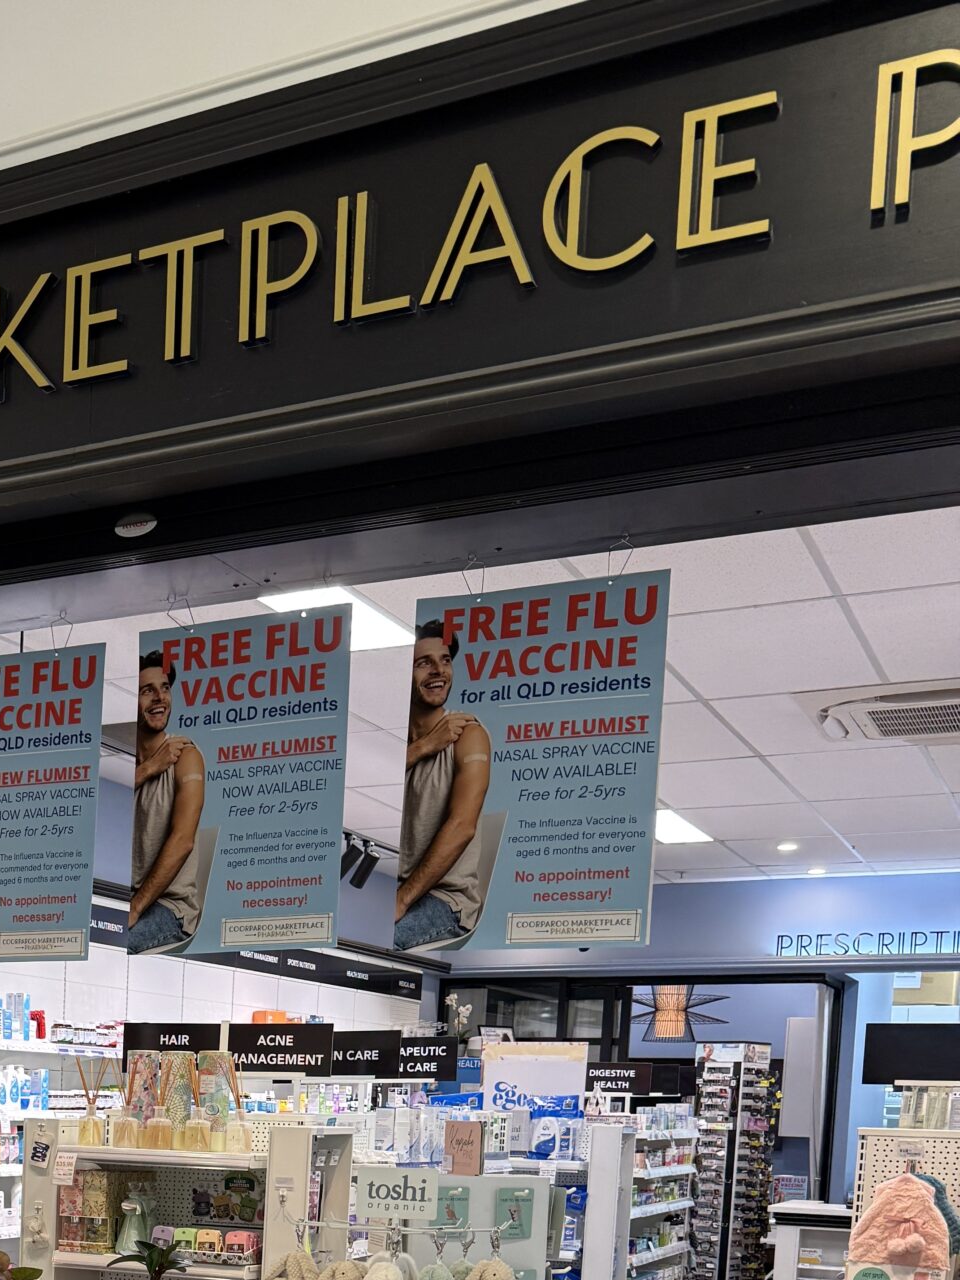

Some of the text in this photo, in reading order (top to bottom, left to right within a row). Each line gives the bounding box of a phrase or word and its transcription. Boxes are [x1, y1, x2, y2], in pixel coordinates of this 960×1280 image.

[442, 584, 659, 646] FREE FLU
[162, 615, 343, 675] FREE FLU
[464, 635, 638, 682] VACCINE
[31, 655, 97, 694] FLU
[181, 662, 326, 707] VACCINE
[460, 673, 651, 704] for all QLD residents
[178, 697, 338, 729] for all QLD residents
[506, 715, 650, 741] NEW FLUMIST
[28, 730, 92, 749] residents
[217, 735, 337, 761] NEW FLUMIST
[493, 740, 656, 763] NASAL SPRAY VACCINE
[27, 765, 91, 784] FLUMIST
[207, 759, 343, 782] NASAL SPRAY VACCINE
[511, 762, 637, 781] NOW AVAILABLE!
[15, 789, 48, 804] SPRAY
[49, 786, 95, 800] VACCINE
[222, 778, 327, 799] NOW AVAILABLE!
[518, 784, 626, 802] Free for 2-5yrs
[23, 805, 82, 819] AVAILABLE!
[228, 800, 318, 818] Free for 2-5yrs
[518, 814, 637, 829] The Influenza Vaccine is
[0, 824, 74, 839] Free for 2-5yrs
[229, 827, 328, 842] The Influenza Vaccine is
[508, 830, 646, 844] recommended for everyone
[14, 852, 44, 860] Influenza
[45, 850, 74, 859] Vaccine
[220, 840, 336, 855] recommended for everyone
[516, 844, 636, 859] aged 6 months and over
[43, 863, 53, 871] for
[54, 862, 89, 872] everyone
[226, 853, 327, 869] aged 6 months and over
[0, 877, 16, 887] aged
[23, 875, 48, 883] months
[64, 874, 81, 882] over
[226, 874, 323, 892] No appointment
[514, 866, 630, 885] No appointment
[0, 893, 77, 908] No appointment
[242, 894, 308, 909] necessary!
[532, 887, 612, 903] necessary!
[12, 911, 65, 924] necessary!
[516, 918, 632, 929] COORPAROO MARKETPLACE
[160, 1034, 189, 1046] HAIR
[257, 1034, 294, 1046] ACNE
[233, 1053, 324, 1067] MANAGEMENT
[346, 1050, 379, 1062] CARE
[407, 1062, 437, 1073] CARE
[589, 1069, 636, 1078] DIGESTIVE
[594, 1081, 629, 1089] HEALTH
[367, 1174, 427, 1203] toshi
[368, 1202, 425, 1212] organic
